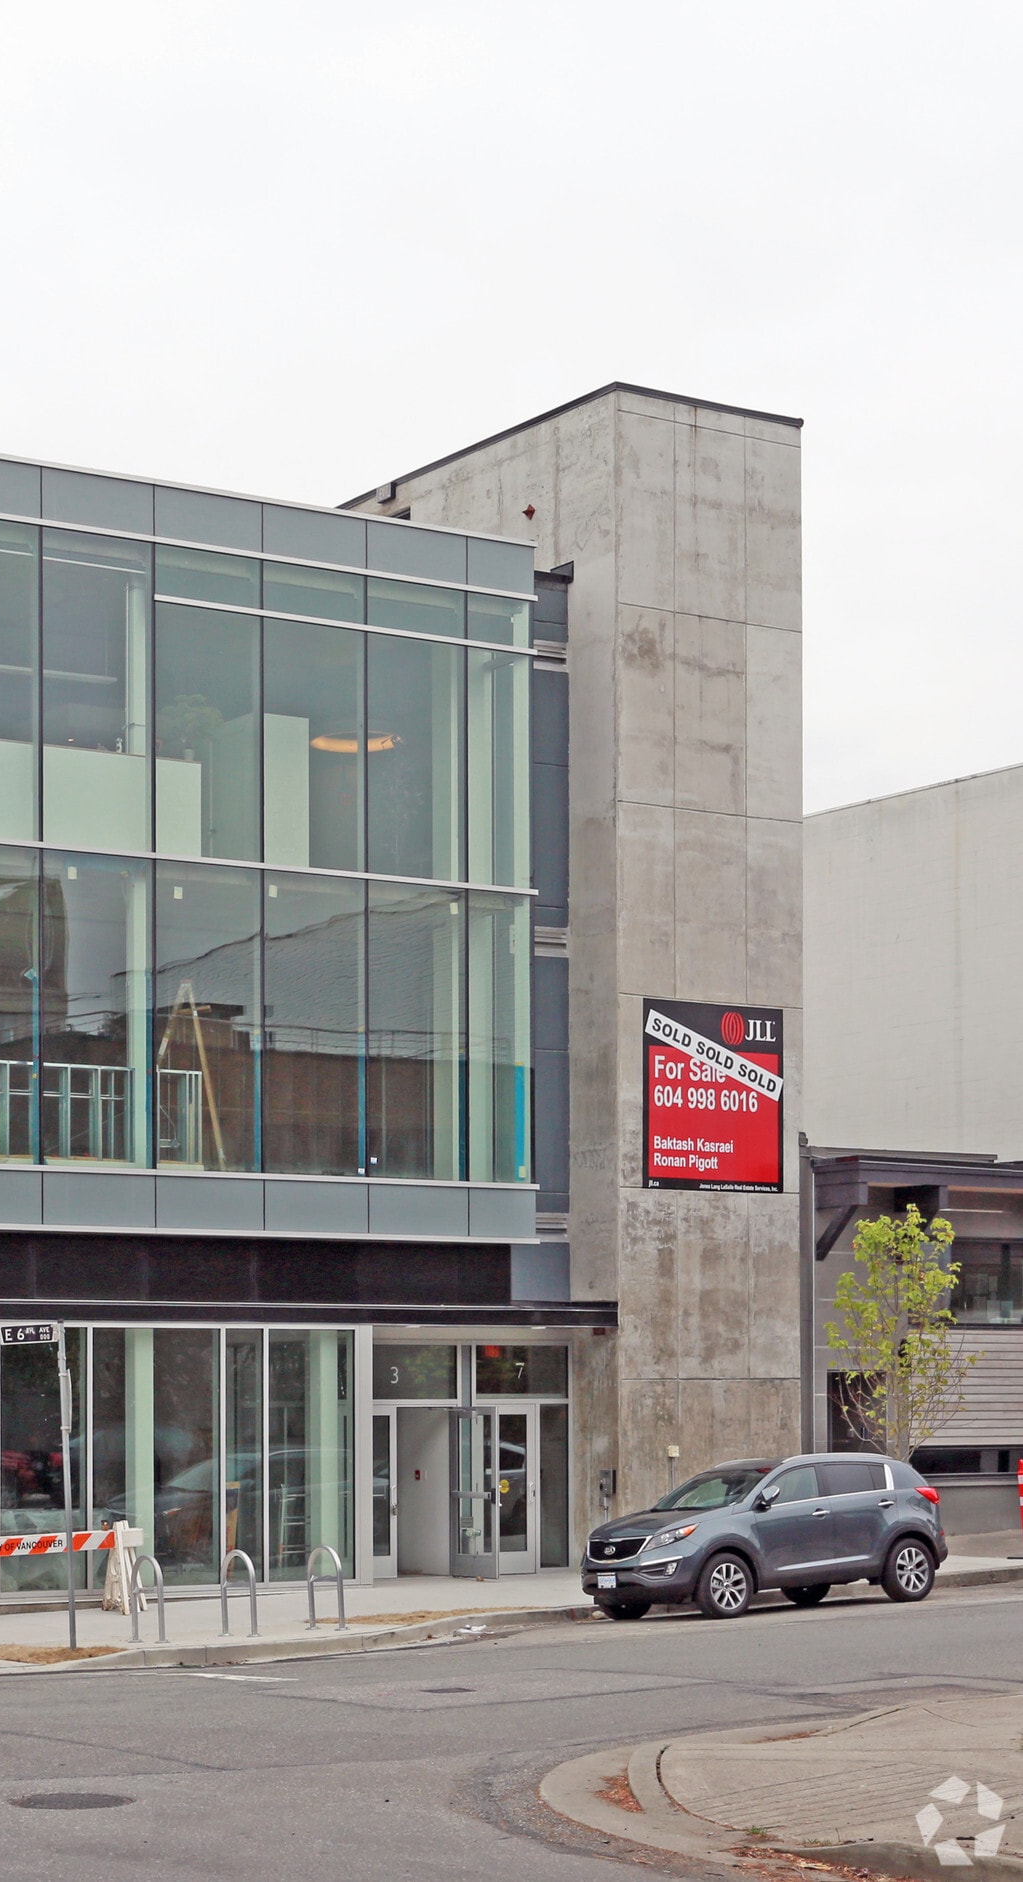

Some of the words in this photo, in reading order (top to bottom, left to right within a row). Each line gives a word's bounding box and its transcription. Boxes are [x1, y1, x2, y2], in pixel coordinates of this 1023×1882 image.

[745, 1019, 776, 1042] JLL
[652, 1018, 691, 1047] SOLD
[696, 1041, 733, 1070] SOLD
[738, 1064, 776, 1092] SOLD
[654, 1055, 684, 1080] For
[689, 1058, 726, 1083] Sale
[654, 1085, 683, 1108] 604
[687, 1087, 716, 1111] 998
[720, 1089, 758, 1113] 6016
[654, 1135, 694, 1151] Baktash
[697, 1138, 734, 1153] Kasraei
[654, 1153, 686, 1167] Ronan
[689, 1154, 718, 1172] Pigott
[5, 1328, 13, 1341] E
[38, 1326, 50, 1334] AVE
[390, 1366, 399, 1384] 3
[515, 1362, 525, 1379] 7
[4, 1542, 16, 1552] OF
[16, 1539, 63, 1551] VANCOUVER
